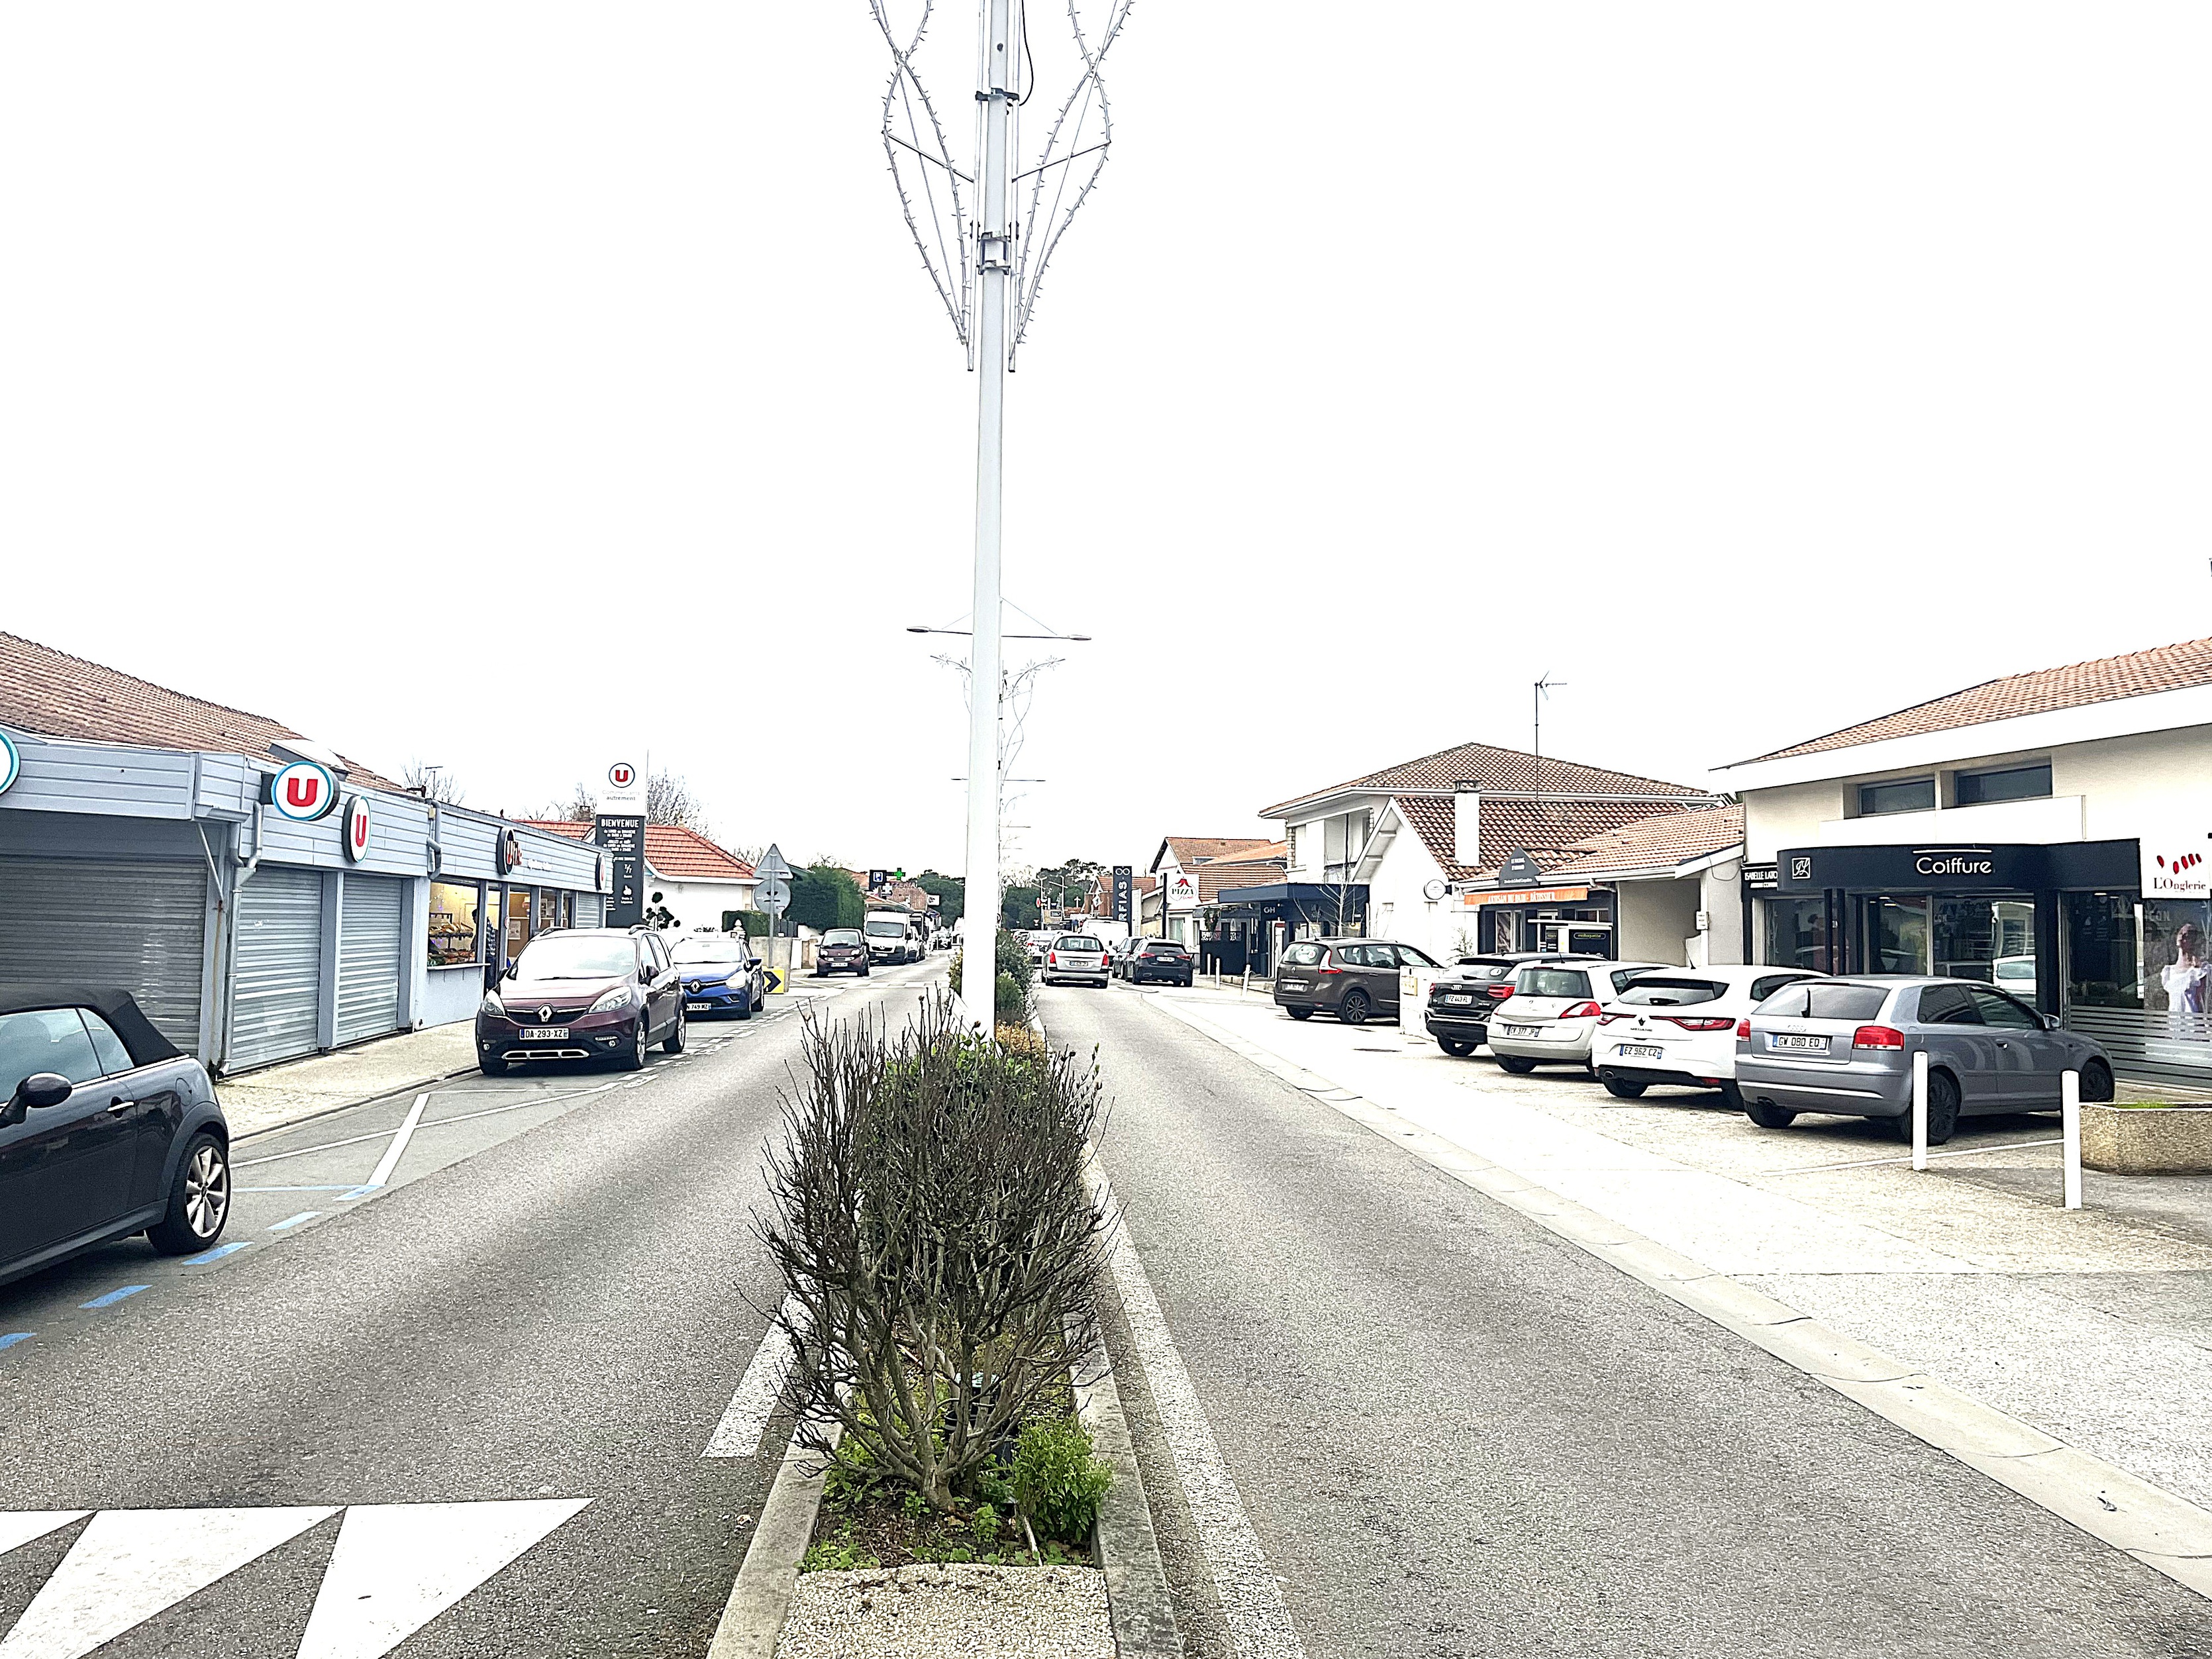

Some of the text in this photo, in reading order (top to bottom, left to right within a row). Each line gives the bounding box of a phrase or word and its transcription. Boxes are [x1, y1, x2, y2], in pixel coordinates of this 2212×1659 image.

[615, 770, 628, 782] U
[287, 778, 319, 807] U
[601, 819, 639, 828] BIENVENUE
[356, 814, 367, 847] U
[1916, 857, 1992, 874] Coiffure
[2153, 877, 2207, 891] L'Onglerie
[1779, 1037, 1788, 1046] GW
[1625, 1046, 1633, 1055] EZ
[1648, 1048, 1657, 1057] CZ
